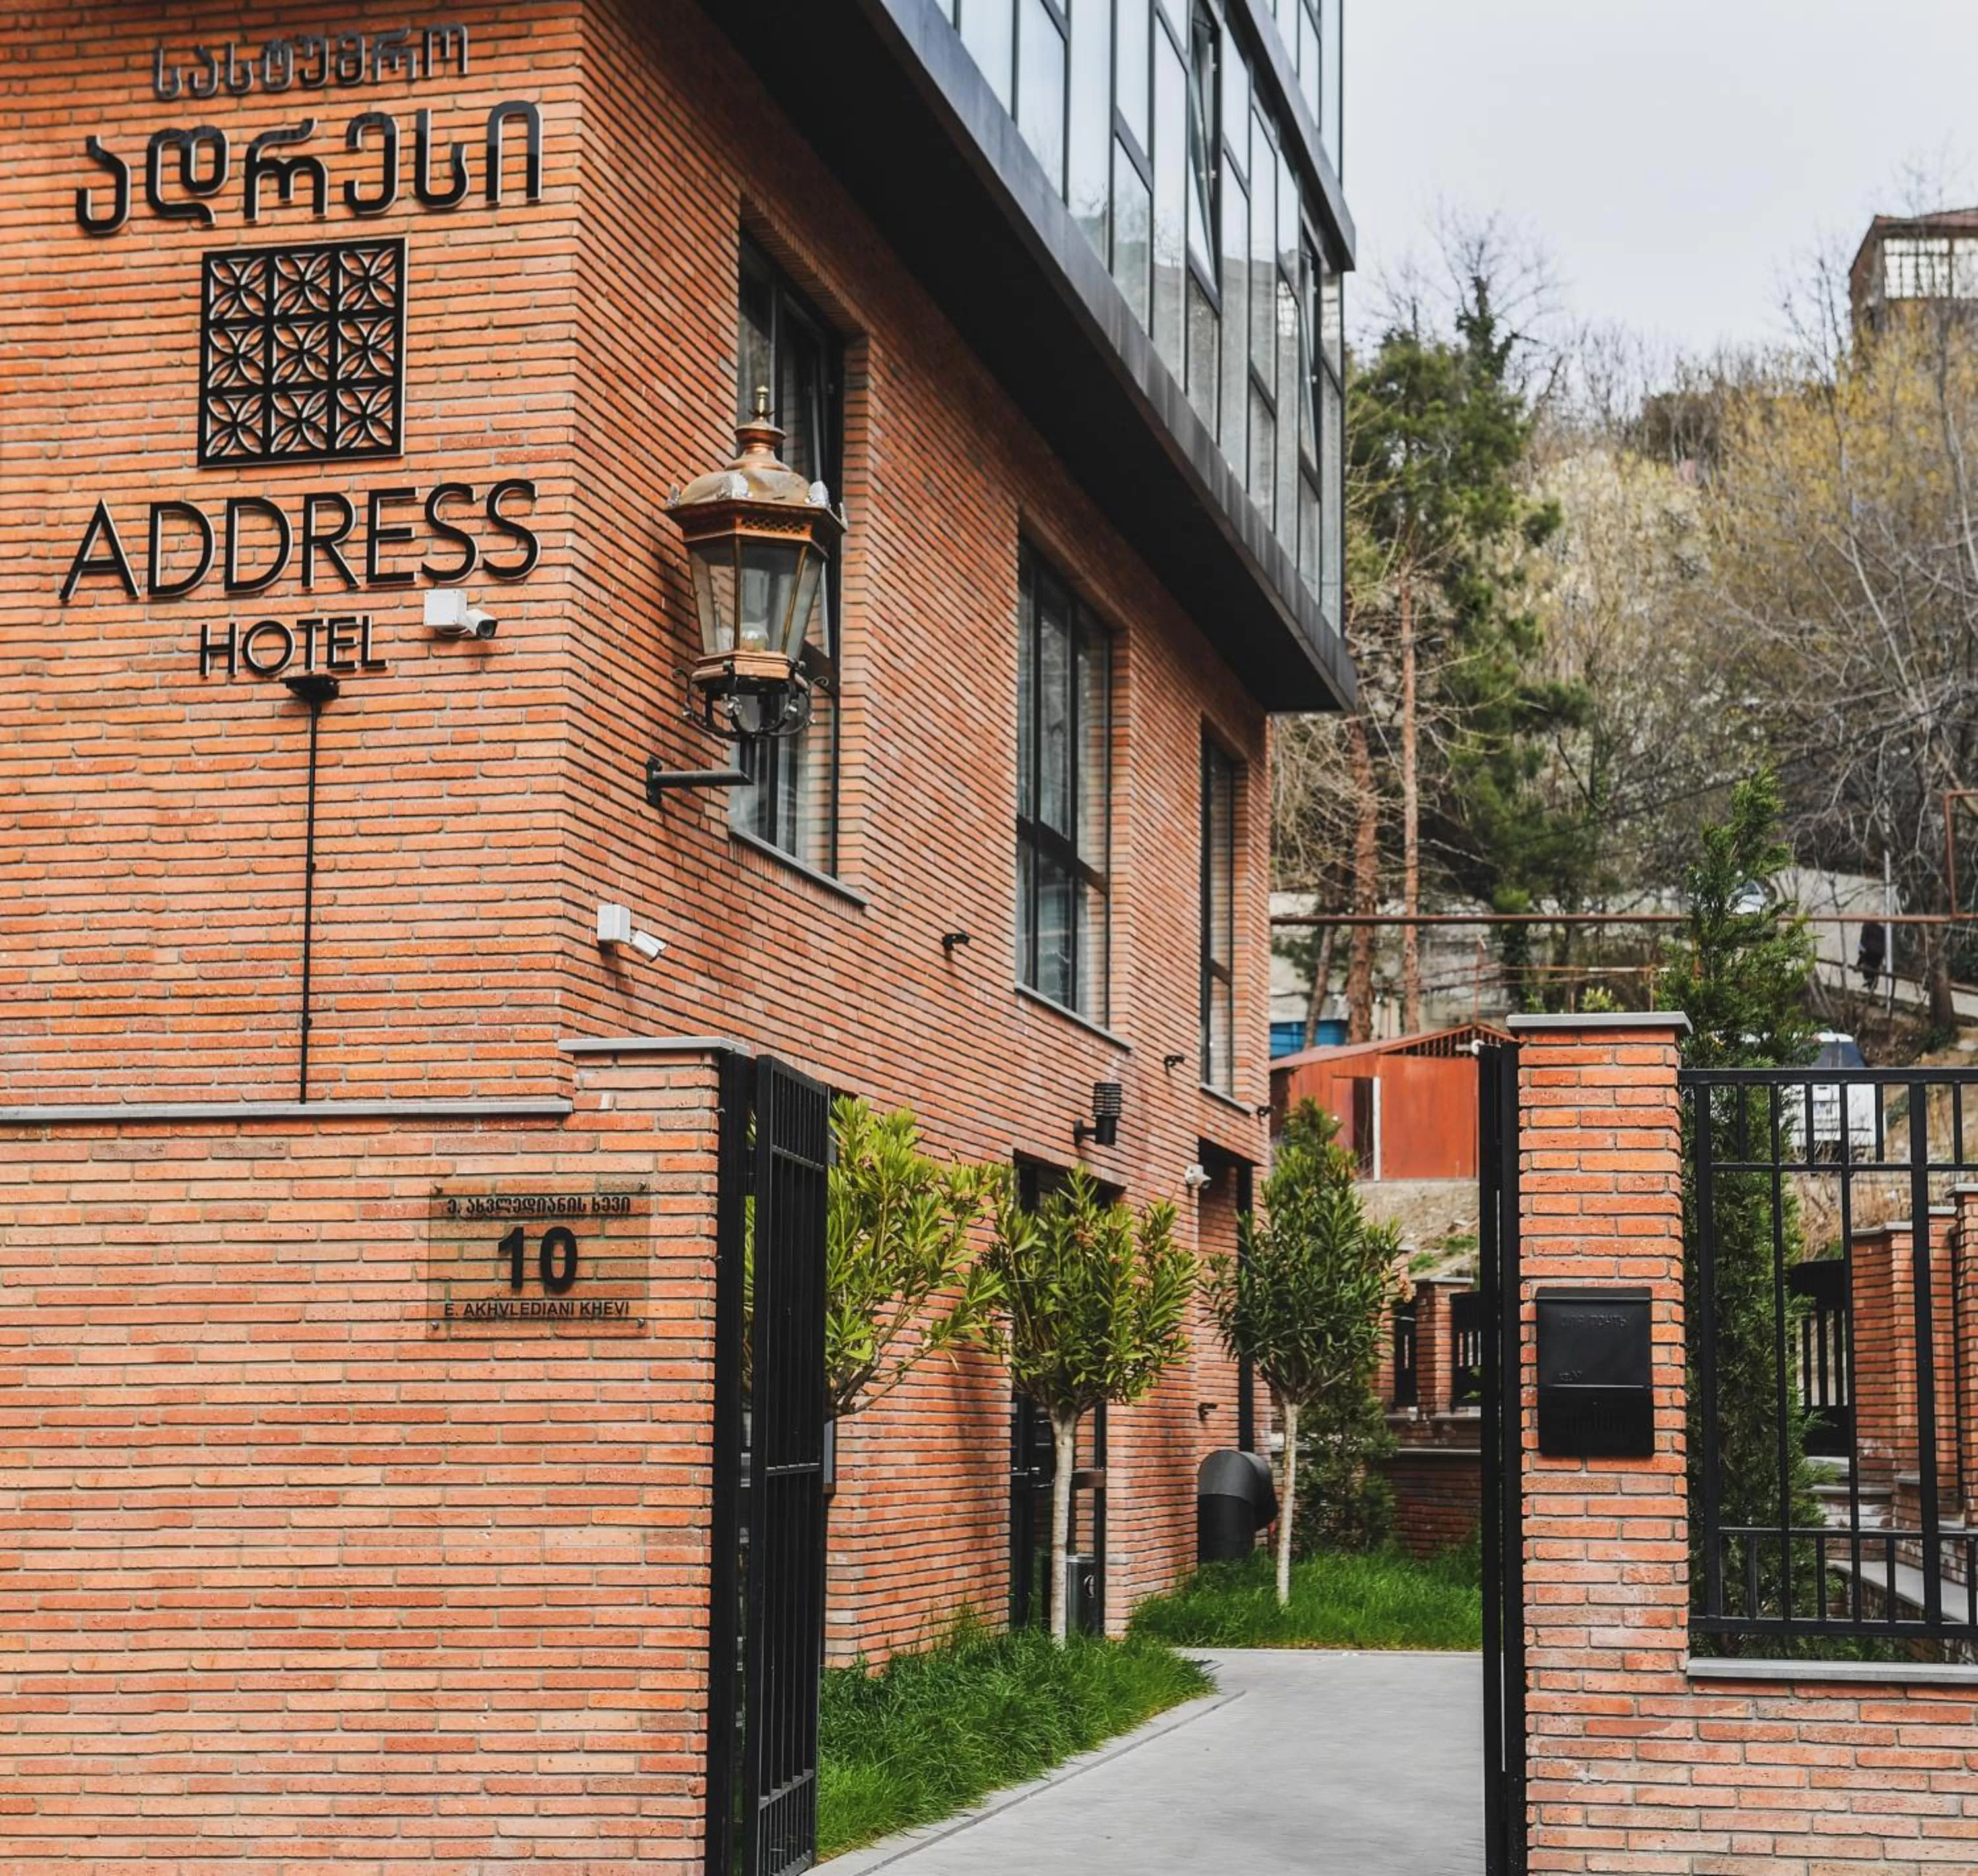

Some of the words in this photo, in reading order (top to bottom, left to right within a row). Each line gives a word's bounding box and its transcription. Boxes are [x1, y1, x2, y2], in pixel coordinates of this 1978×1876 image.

[152, 22, 469, 101] სასტუმრო
[76, 100, 545, 235] ადრესი
[59, 478, 542, 602] ADDRESS
[199, 615, 388, 678] HOTEL
[591, 1196, 631, 1213] ხევი
[498, 1226, 578, 1294] 10
[444, 1303, 459, 1316] E.
[463, 1302, 575, 1316] AKHVLEDIANI
[580, 1301, 629, 1316] KHEVI
